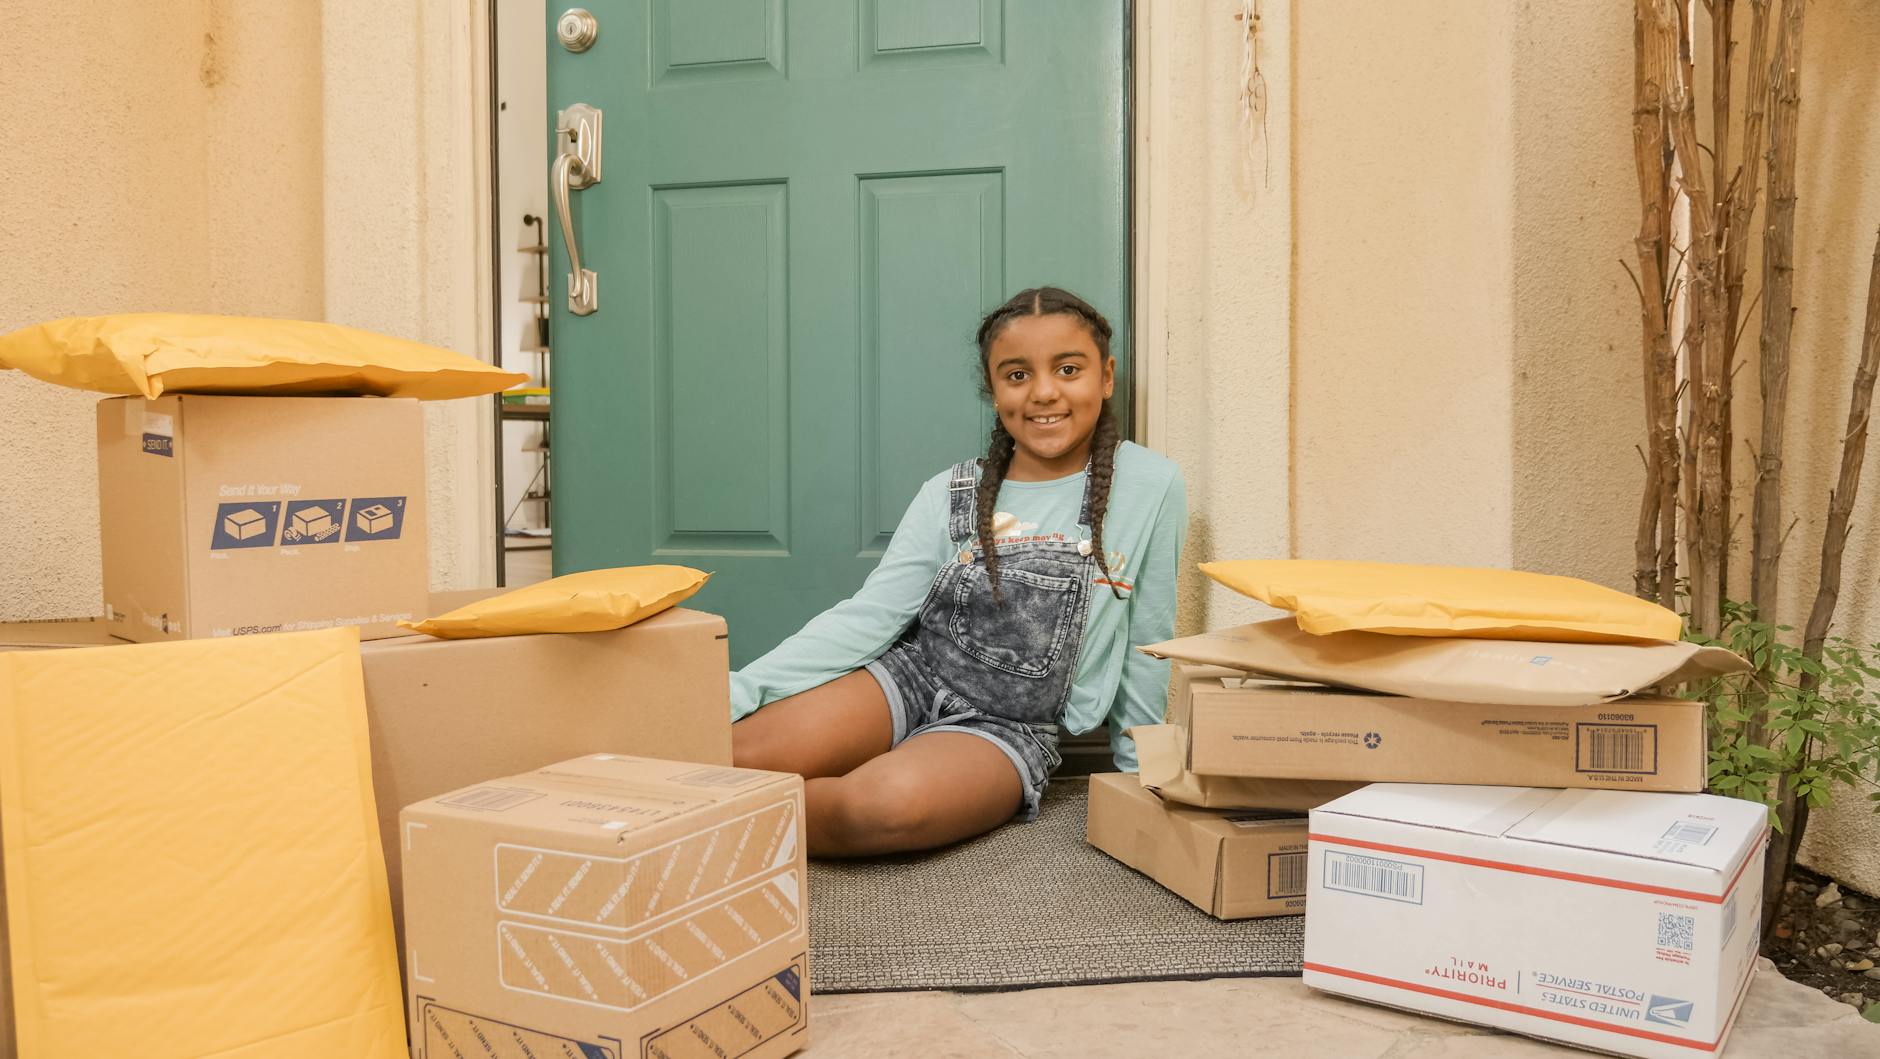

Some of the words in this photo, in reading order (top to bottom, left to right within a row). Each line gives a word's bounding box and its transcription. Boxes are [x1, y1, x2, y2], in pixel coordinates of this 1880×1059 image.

[219, 484, 245, 496] Send
[256, 484, 279, 496] Your
[280, 483, 301, 496] Way
[337, 502, 342, 510] 2
[1008, 536, 1030, 544] keep
[1033, 533, 1065, 544] movng
[1451, 956, 1488, 972] MAIL
[1541, 991, 1587, 1009] STATES
[1595, 984, 1645, 1002] POSTAL
[1589, 1002, 1640, 1020] UNITED
